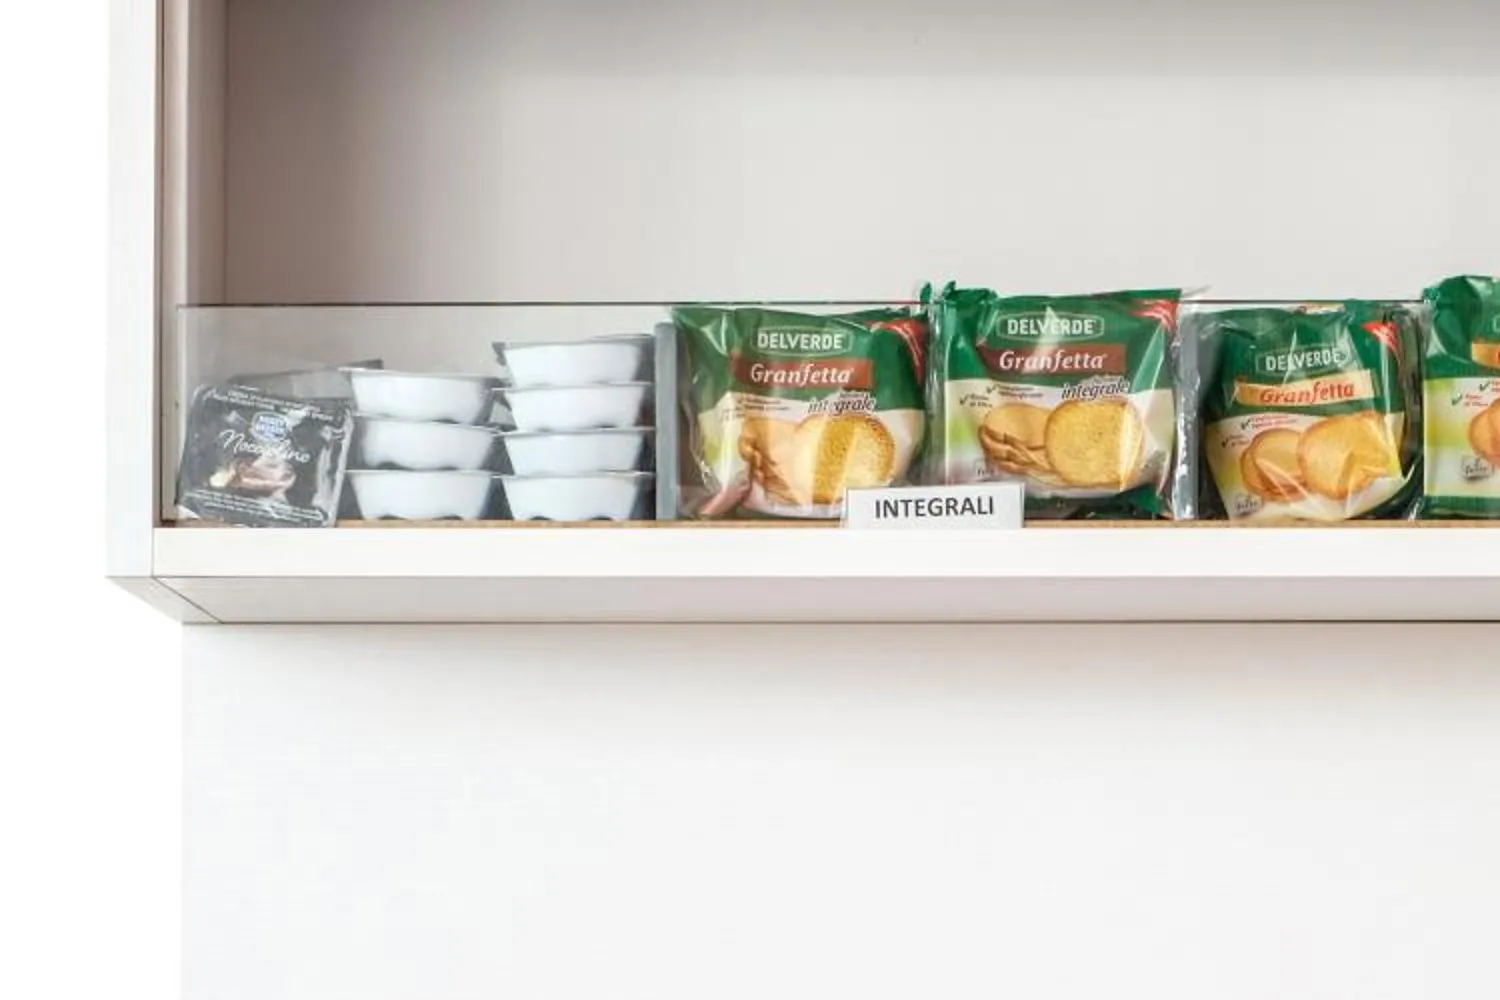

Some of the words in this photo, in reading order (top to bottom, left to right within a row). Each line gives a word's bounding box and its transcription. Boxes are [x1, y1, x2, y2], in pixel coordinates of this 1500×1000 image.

[1007, 318, 1095, 335] DELVERDE
[757, 332, 843, 350] DELVERDE
[1000, 349, 1104, 373] Granfetta
[751, 362, 852, 387] Granfetta
[808, 393, 876, 415] intgrale
[1260, 381, 1355, 404] Granfetta
[875, 495, 994, 518] INTEGRALI
